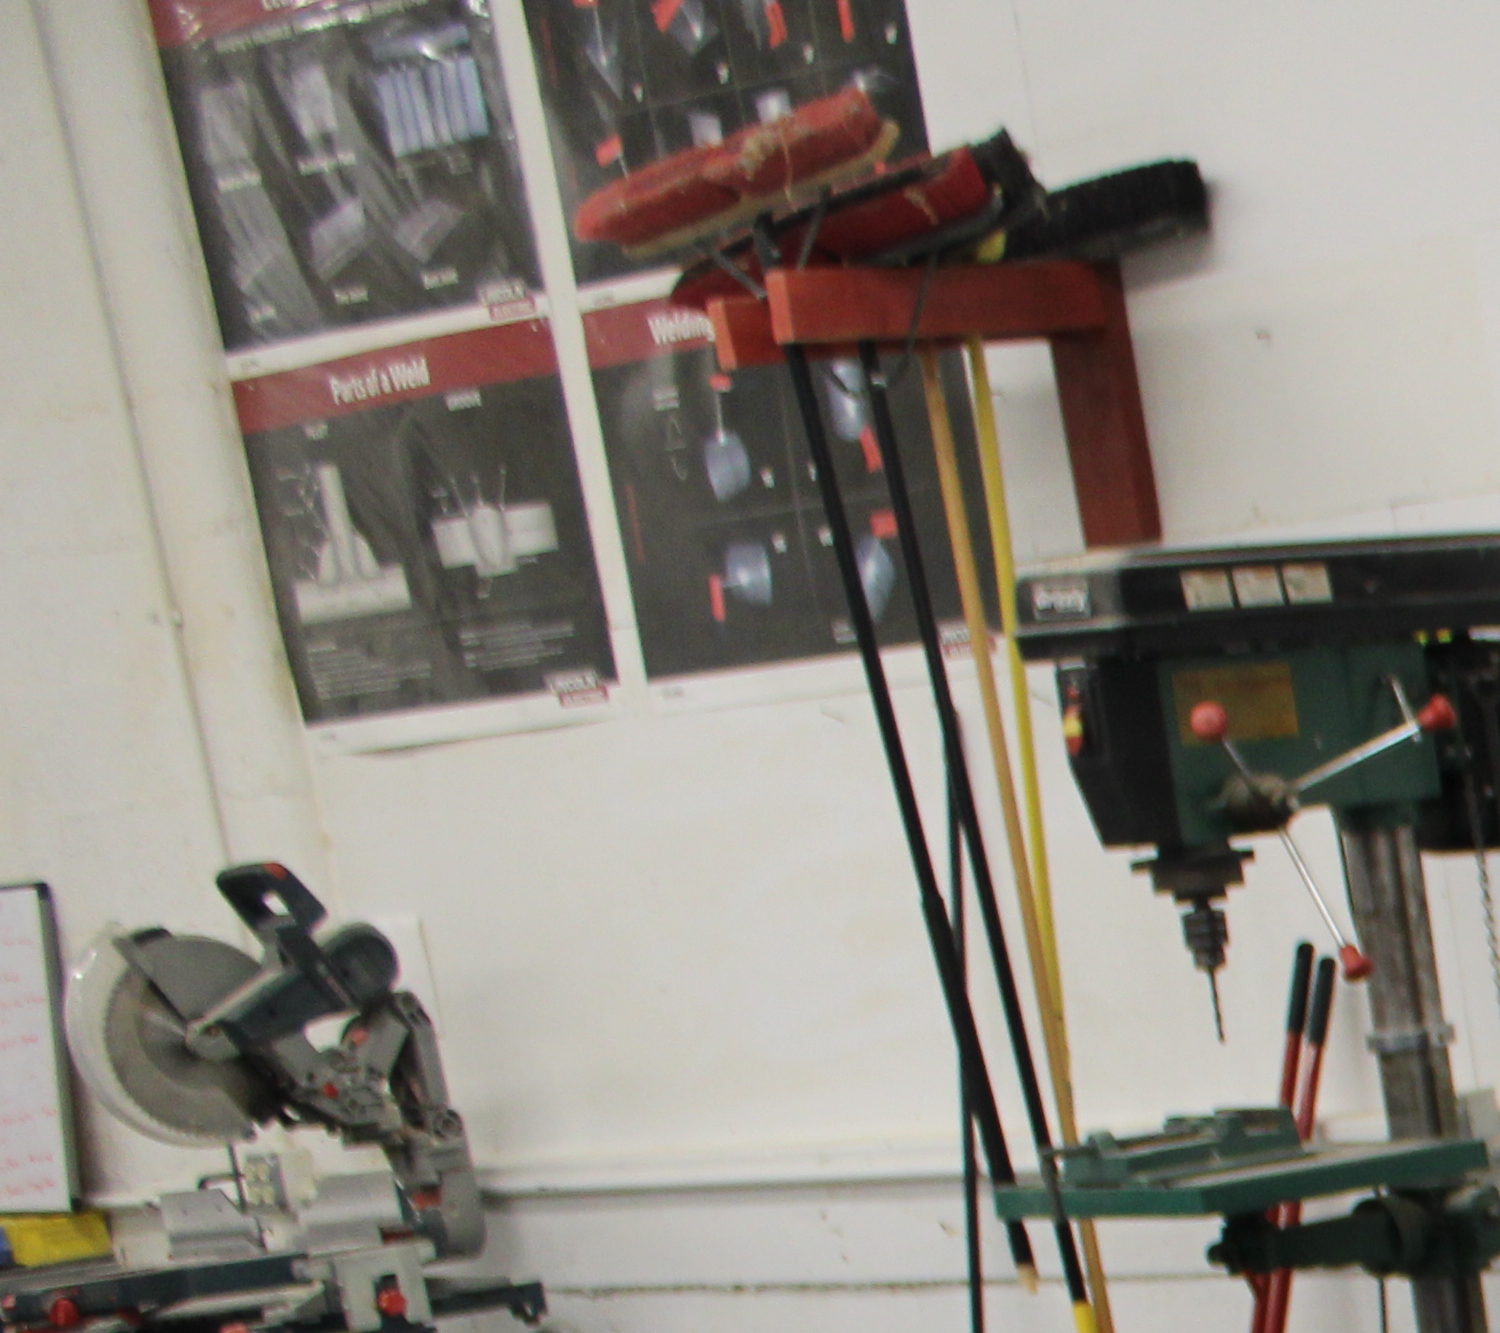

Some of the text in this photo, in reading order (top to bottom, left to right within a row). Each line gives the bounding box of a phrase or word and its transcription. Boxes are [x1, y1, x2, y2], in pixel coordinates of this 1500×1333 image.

[647, 309, 715, 345] Welding
[330, 374, 366, 405] Parts
[365, 367, 381, 397] of
[390, 356, 431, 390] Weld
